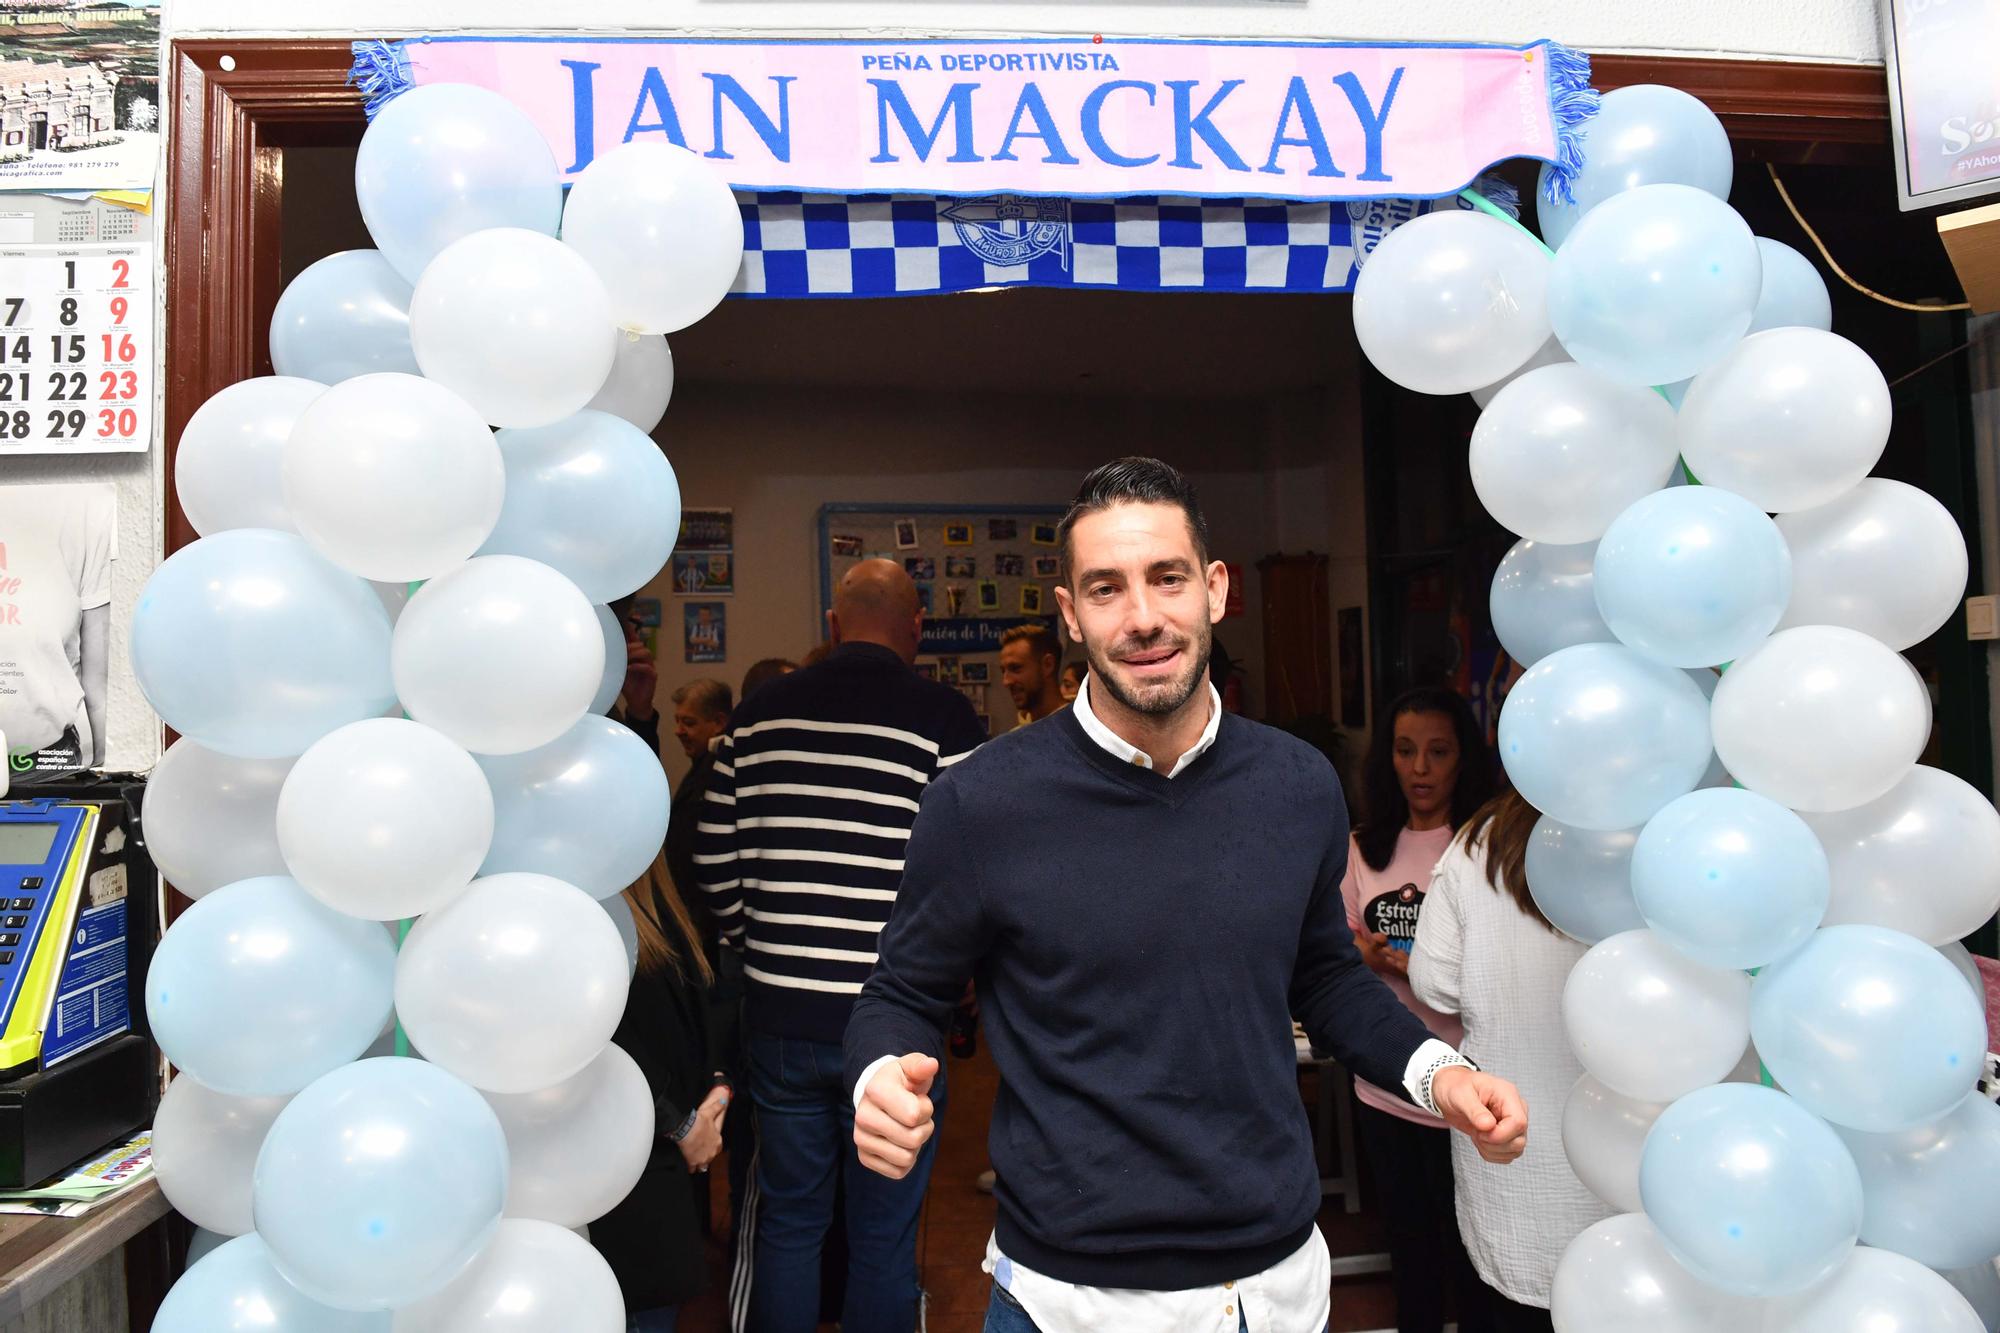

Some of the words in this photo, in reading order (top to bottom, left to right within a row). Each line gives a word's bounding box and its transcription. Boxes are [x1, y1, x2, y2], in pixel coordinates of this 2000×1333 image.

[862, 52, 933, 71] PEÑA
[940, 52, 1120, 71] DEPORTIVISTA
[866, 67, 1406, 182] MACKAY
[1958, 155, 2000, 171] #YAho
[107, 249, 134, 257] Domingo
[65, 261, 75, 289] 1
[111, 259, 129, 288] 2
[5, 298, 25, 326] 7
[60, 297, 78, 326] 8
[110, 297, 128, 324] 9
[0, 335, 31, 363] 14
[51, 335, 86, 363] 15
[101, 334, 136, 362] 16
[0, 373, 29, 401] 21
[47, 372, 87, 400] 22
[99, 370, 137, 400] 23
[46, 409, 86, 438] 29
[97, 408, 137, 437] 30
[961, 624, 974, 639] de
[13, 899, 20, 907] 3
[1378, 918, 1417, 938] Galic
